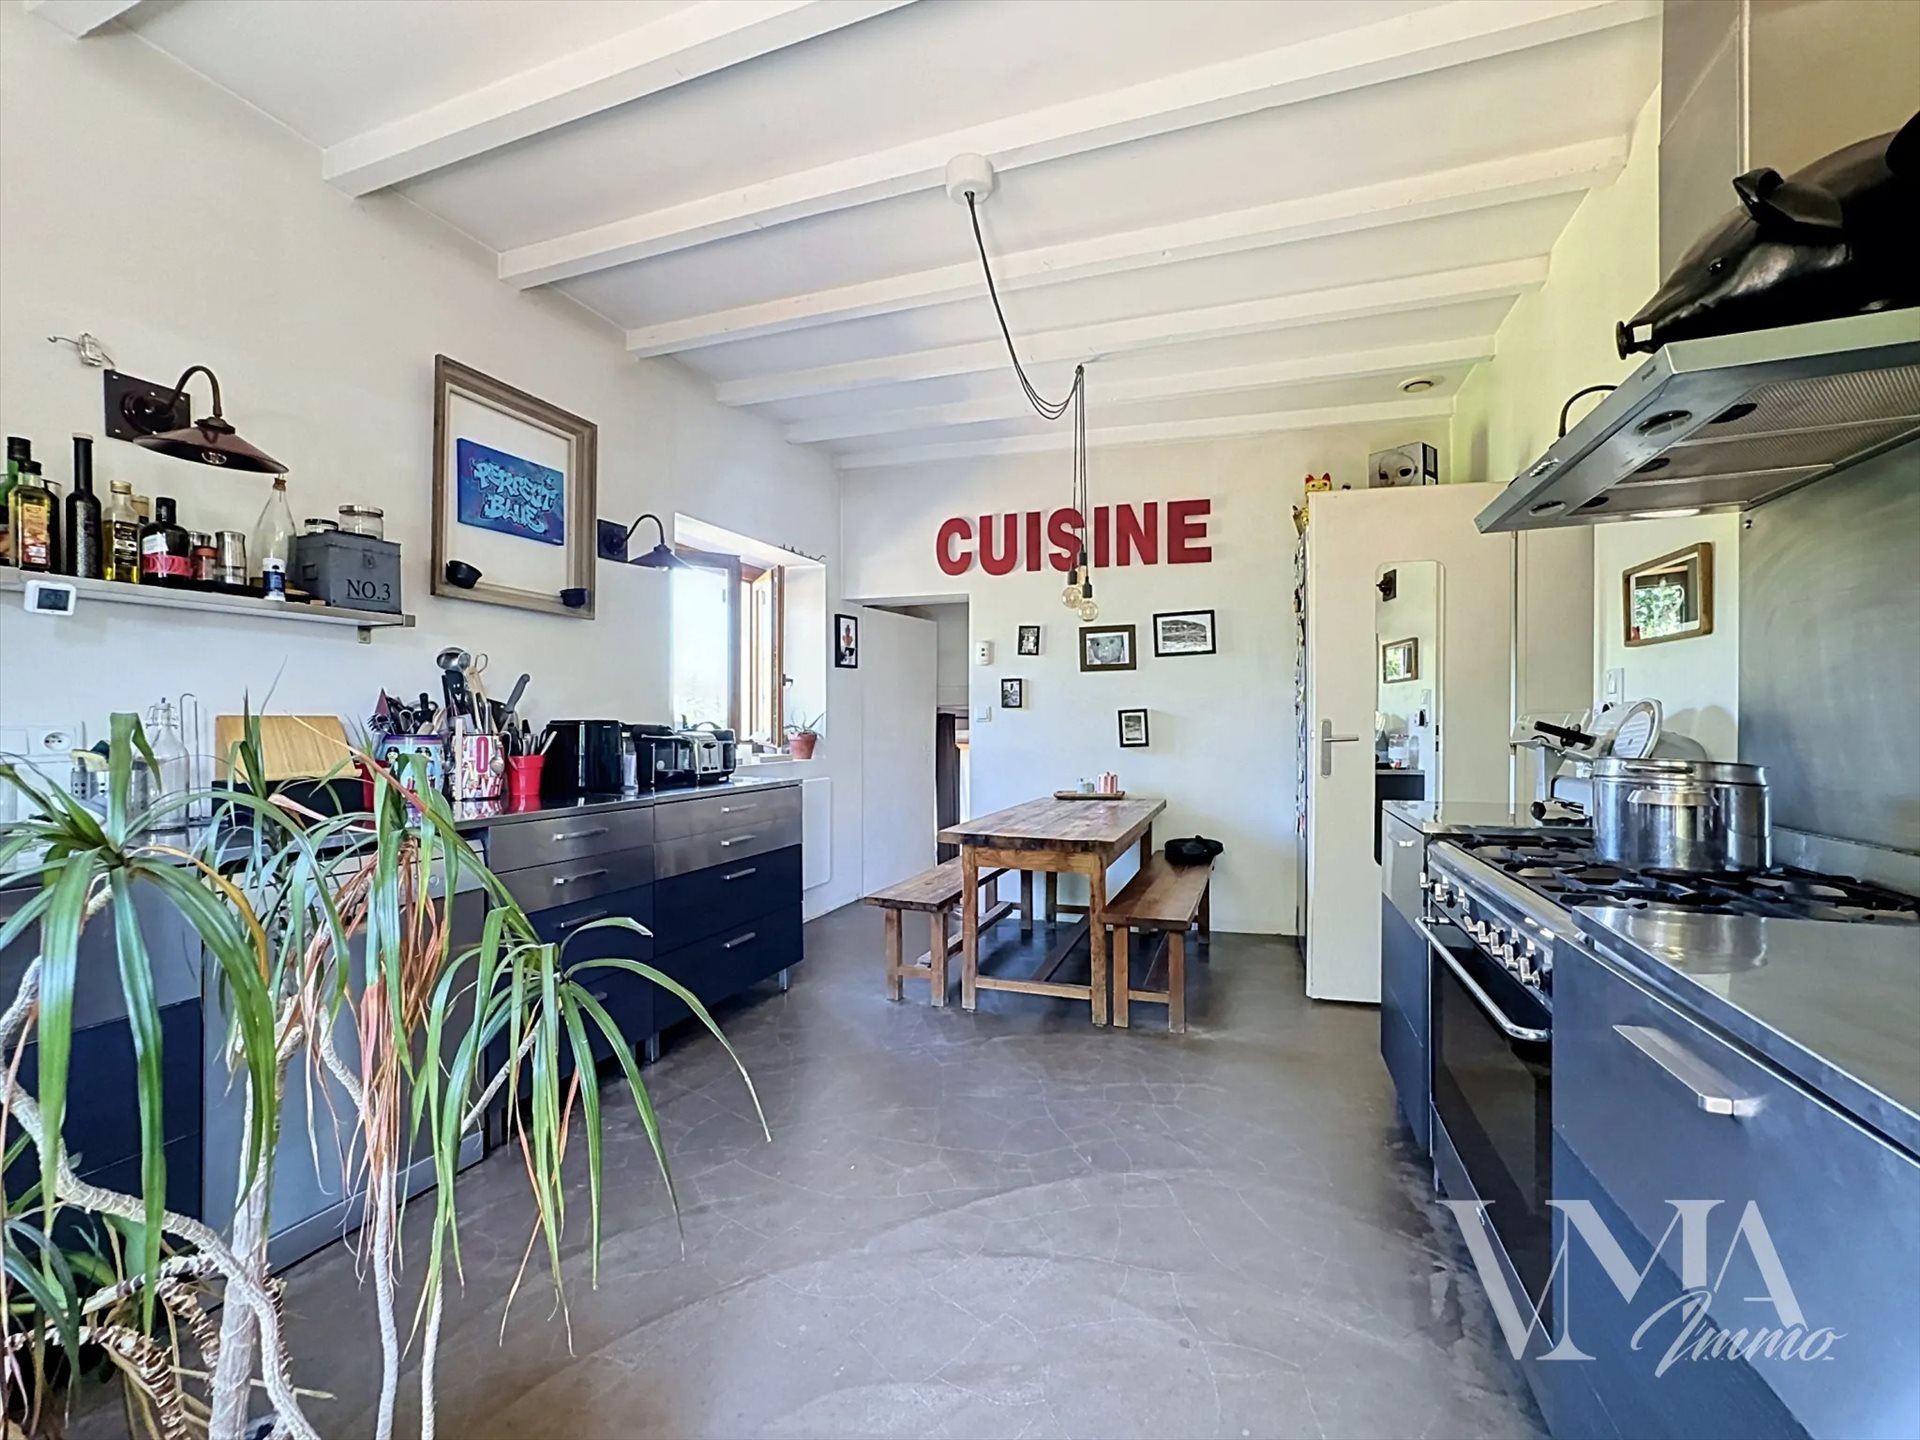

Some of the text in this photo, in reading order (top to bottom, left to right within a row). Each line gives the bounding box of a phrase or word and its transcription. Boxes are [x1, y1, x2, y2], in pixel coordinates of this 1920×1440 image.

[473, 462, 558, 511] PERFECT
[484, 493, 546, 534] BLUE
[936, 499, 1212, 576] CUISINE
[346, 579, 391, 601] NO.3
